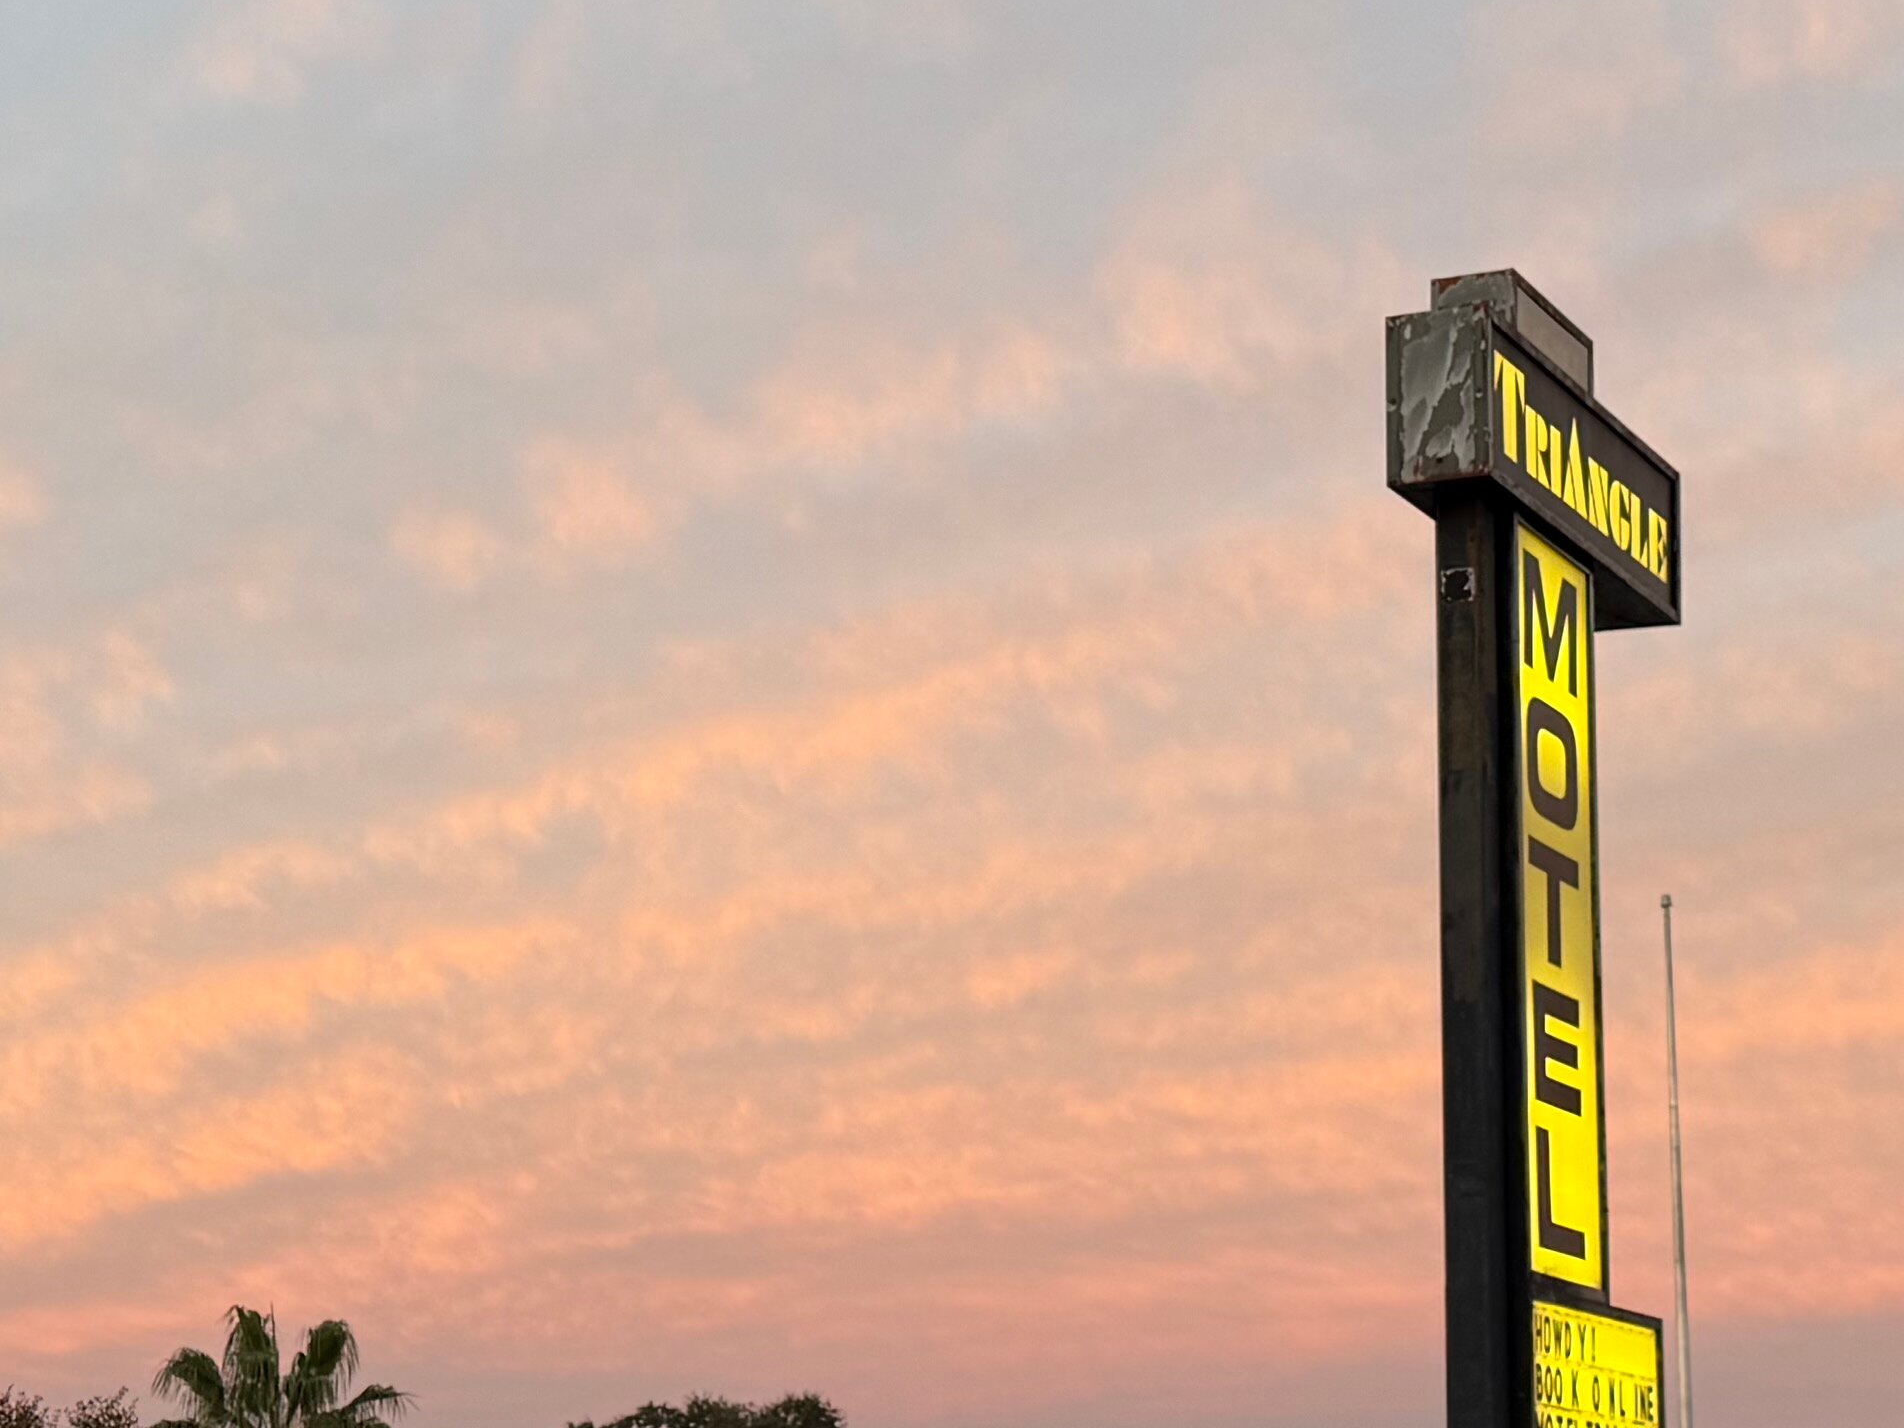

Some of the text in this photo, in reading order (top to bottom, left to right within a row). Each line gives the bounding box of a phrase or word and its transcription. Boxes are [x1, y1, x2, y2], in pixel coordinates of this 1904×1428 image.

[1494, 349, 1668, 584] TRIANGLE
[1522, 547, 1585, 1261] MOTEL
[1534, 1314, 1597, 1362] HOWDY!
[1536, 1363, 1579, 1408] BOOK
